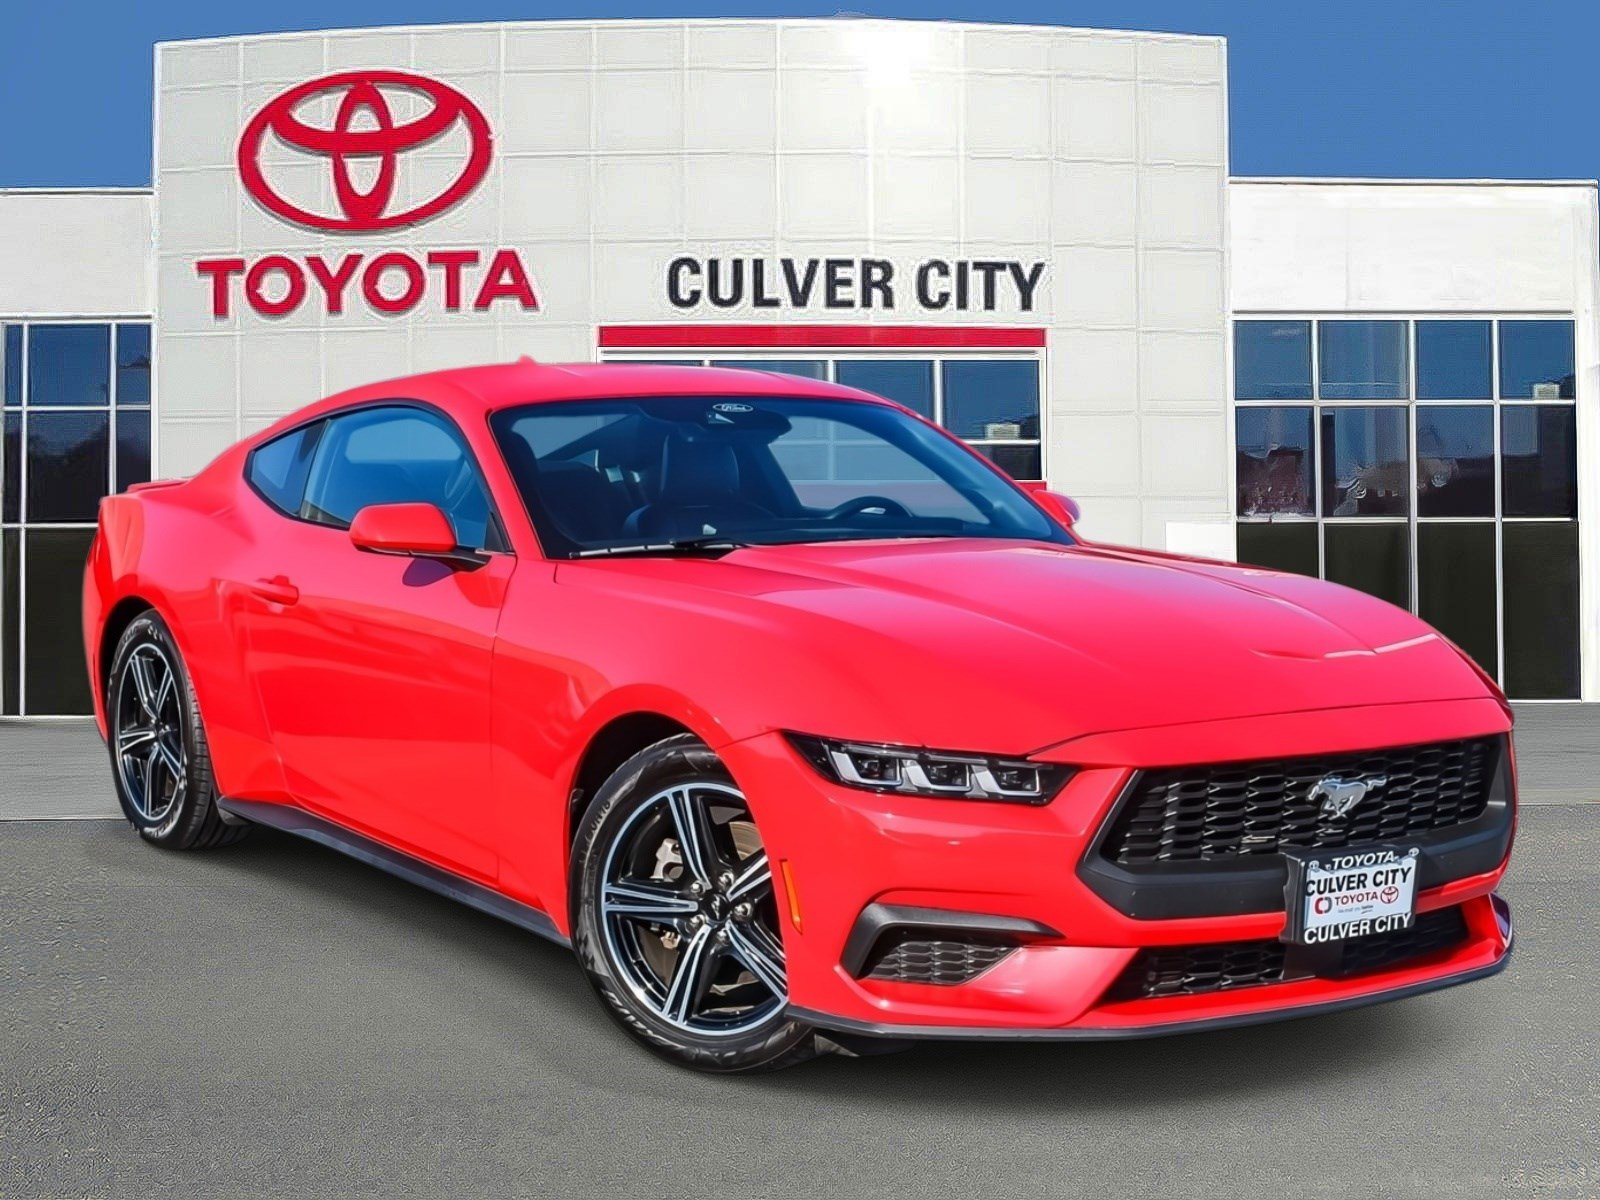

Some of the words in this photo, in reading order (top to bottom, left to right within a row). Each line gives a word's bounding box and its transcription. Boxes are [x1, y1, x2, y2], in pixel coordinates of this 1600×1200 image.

[197, 249, 539, 319] TOYOTA
[667, 257, 895, 309] CULVER
[916, 258, 1046, 312] CITY
[1332, 851, 1394, 870] TOYOTA
[1306, 873, 1367, 896] CULVER
[1373, 867, 1412, 887] CITY
[1335, 892, 1378, 906] TOYOTA
[1304, 919, 1370, 944] CULVER
[1375, 912, 1411, 933] CITY
